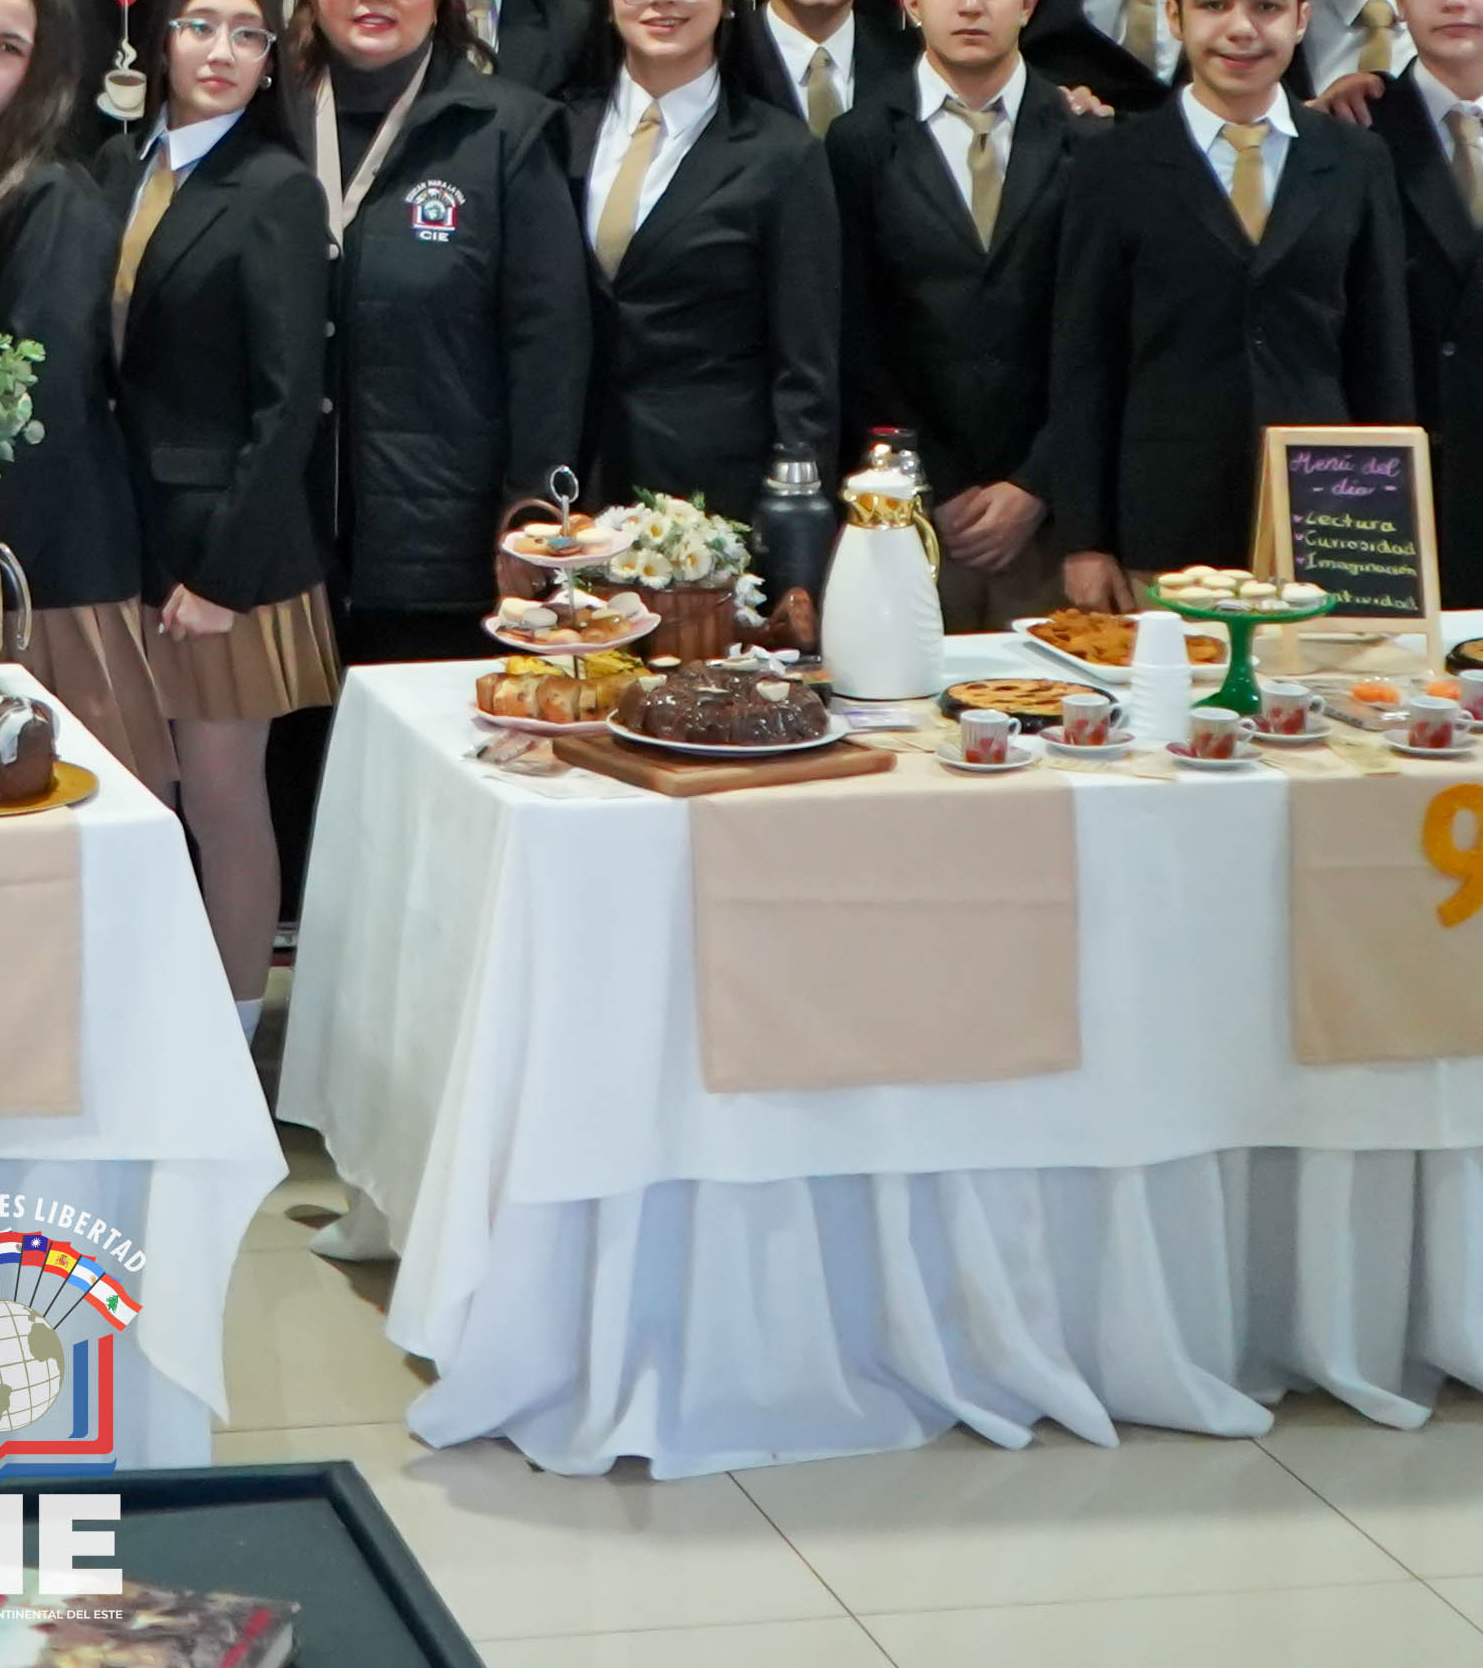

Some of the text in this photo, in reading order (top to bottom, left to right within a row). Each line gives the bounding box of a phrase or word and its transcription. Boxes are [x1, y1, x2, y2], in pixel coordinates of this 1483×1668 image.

[420, 230, 449, 242] CIE
[1290, 452, 1402, 477] Menú del
[1305, 511, 1397, 533] Lectura
[1305, 530, 1416, 556] Curiosidad
